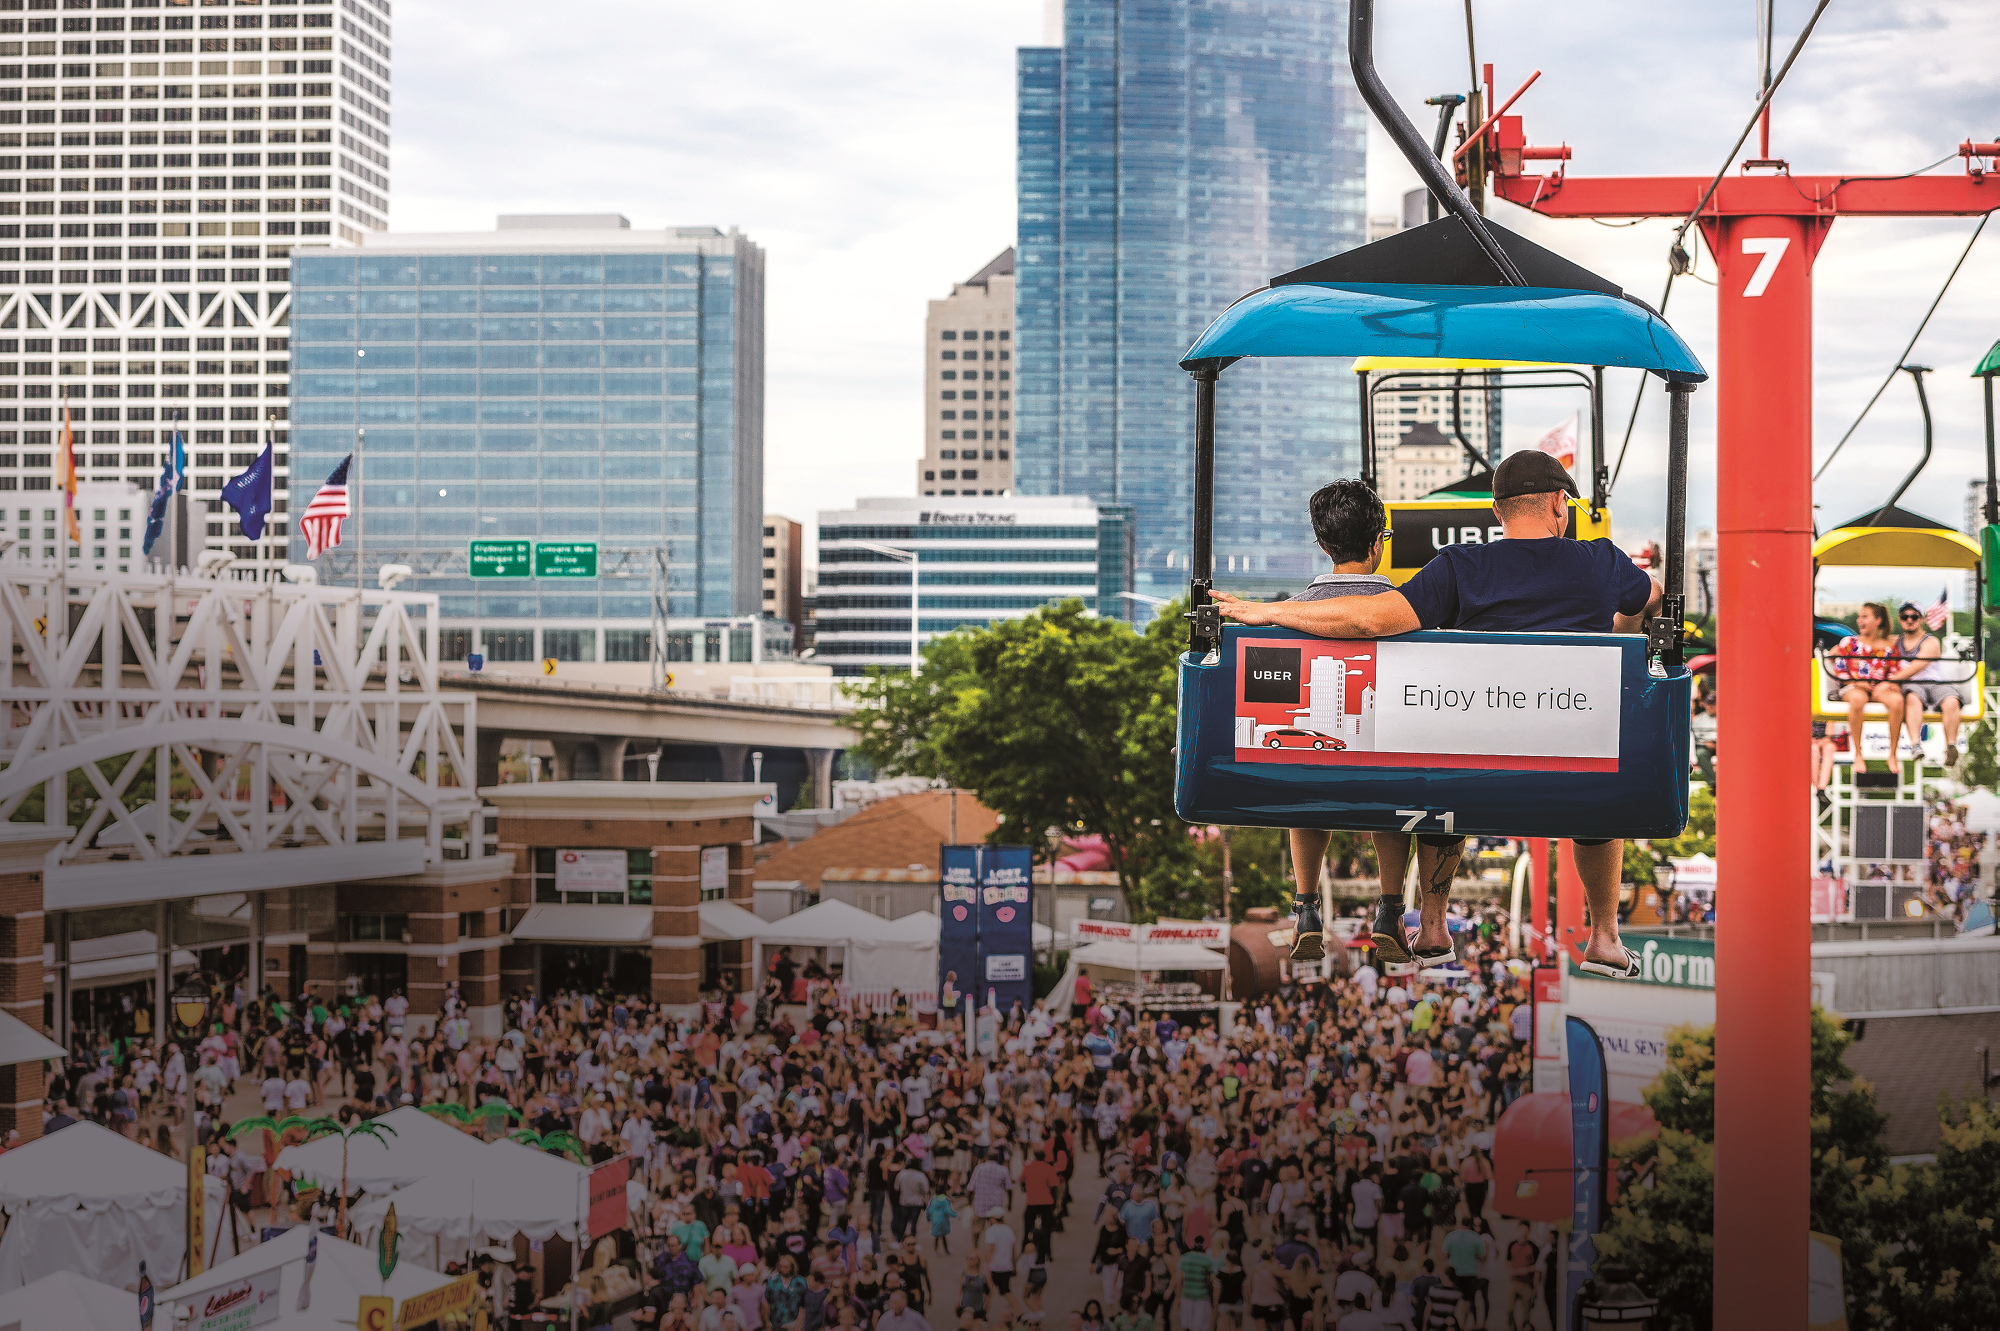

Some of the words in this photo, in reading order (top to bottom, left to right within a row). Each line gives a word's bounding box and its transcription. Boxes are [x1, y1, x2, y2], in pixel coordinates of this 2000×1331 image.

[1741, 237, 1791, 298] 7
[1253, 669, 1292, 682] UBER
[1404, 684, 1476, 712] Enjoy
[1486, 684, 1527, 710] the
[1536, 684, 1594, 712] ride.
[1395, 810, 1455, 834] 71
